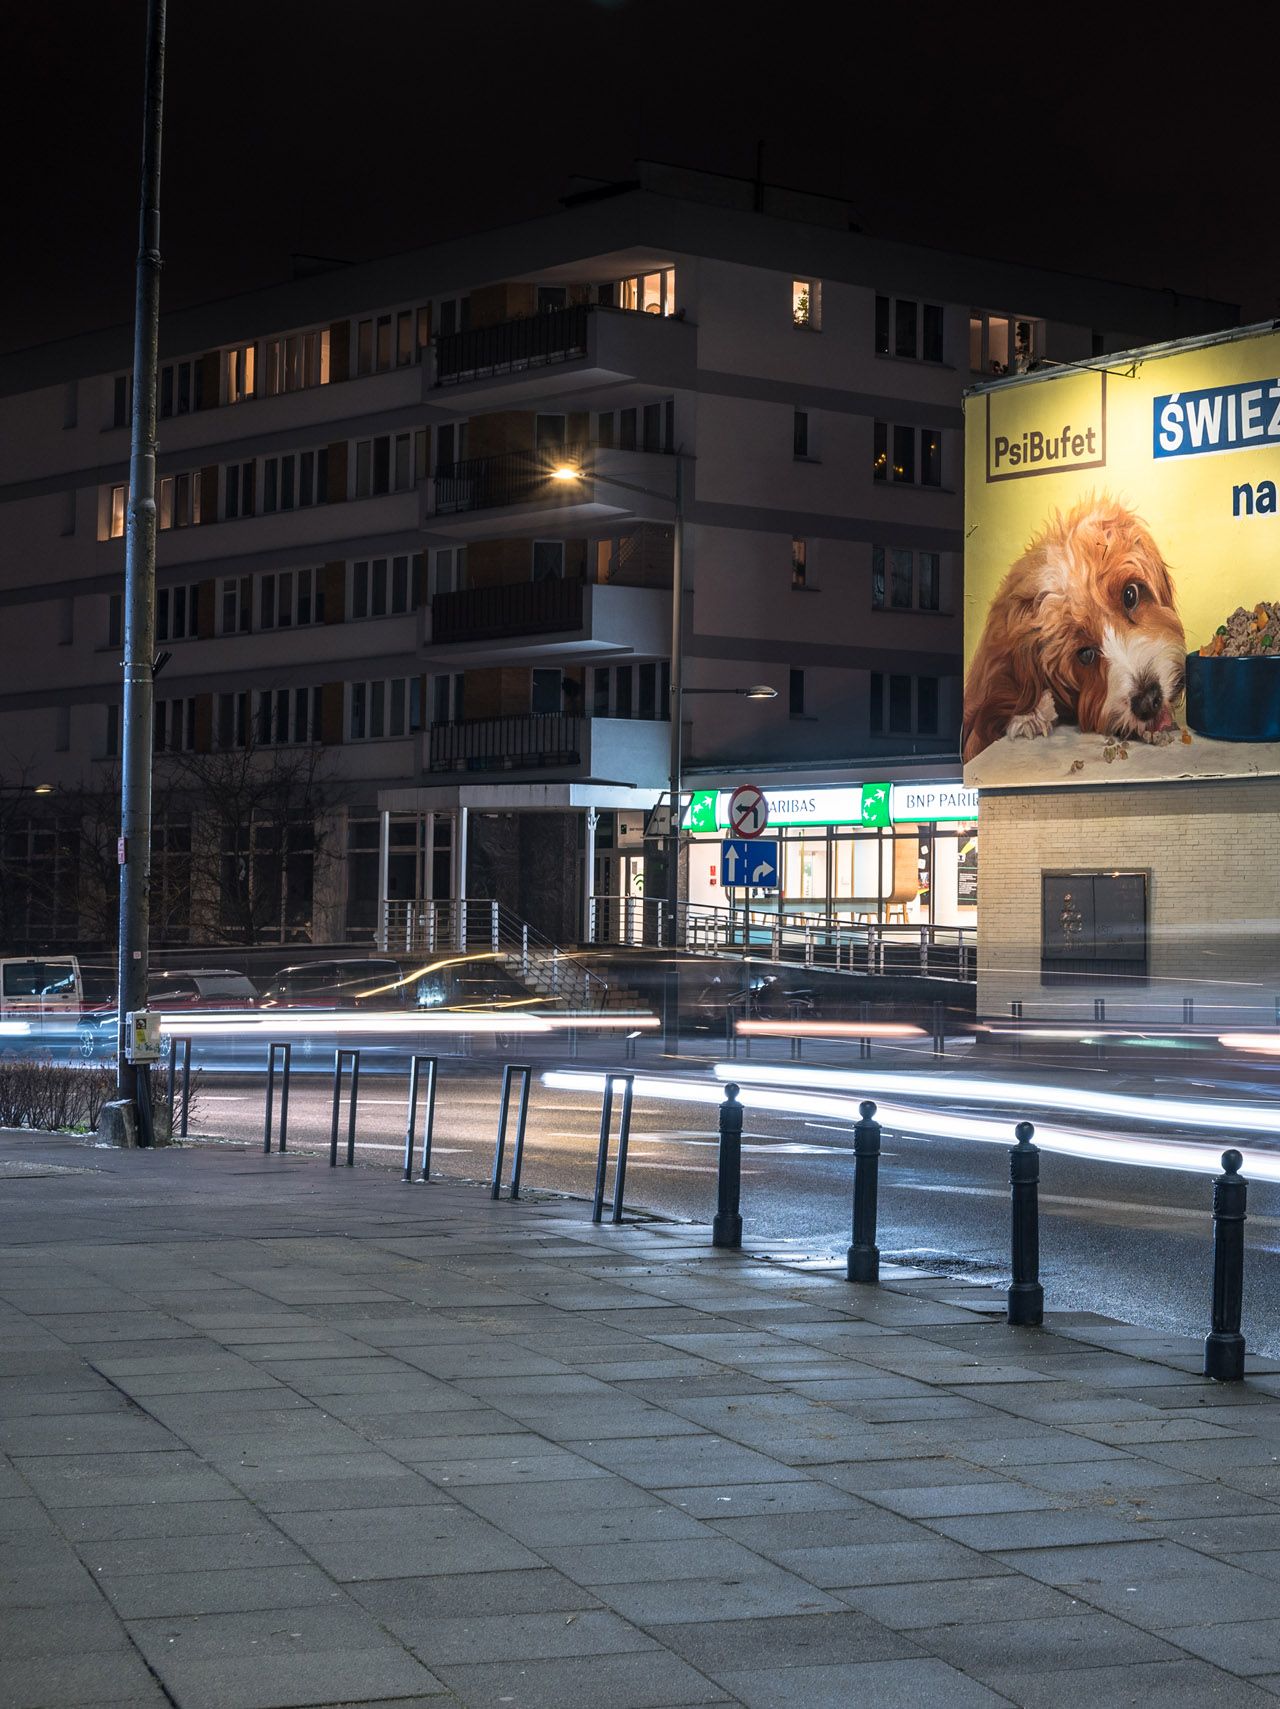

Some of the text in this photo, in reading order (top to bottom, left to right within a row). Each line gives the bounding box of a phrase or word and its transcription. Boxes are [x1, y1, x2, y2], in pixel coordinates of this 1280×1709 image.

[994, 425, 1097, 468] PsiBufet
[1232, 476, 1277, 517] na
[767, 798, 816, 813] ARIBAS
[906, 793, 935, 809] BNP
